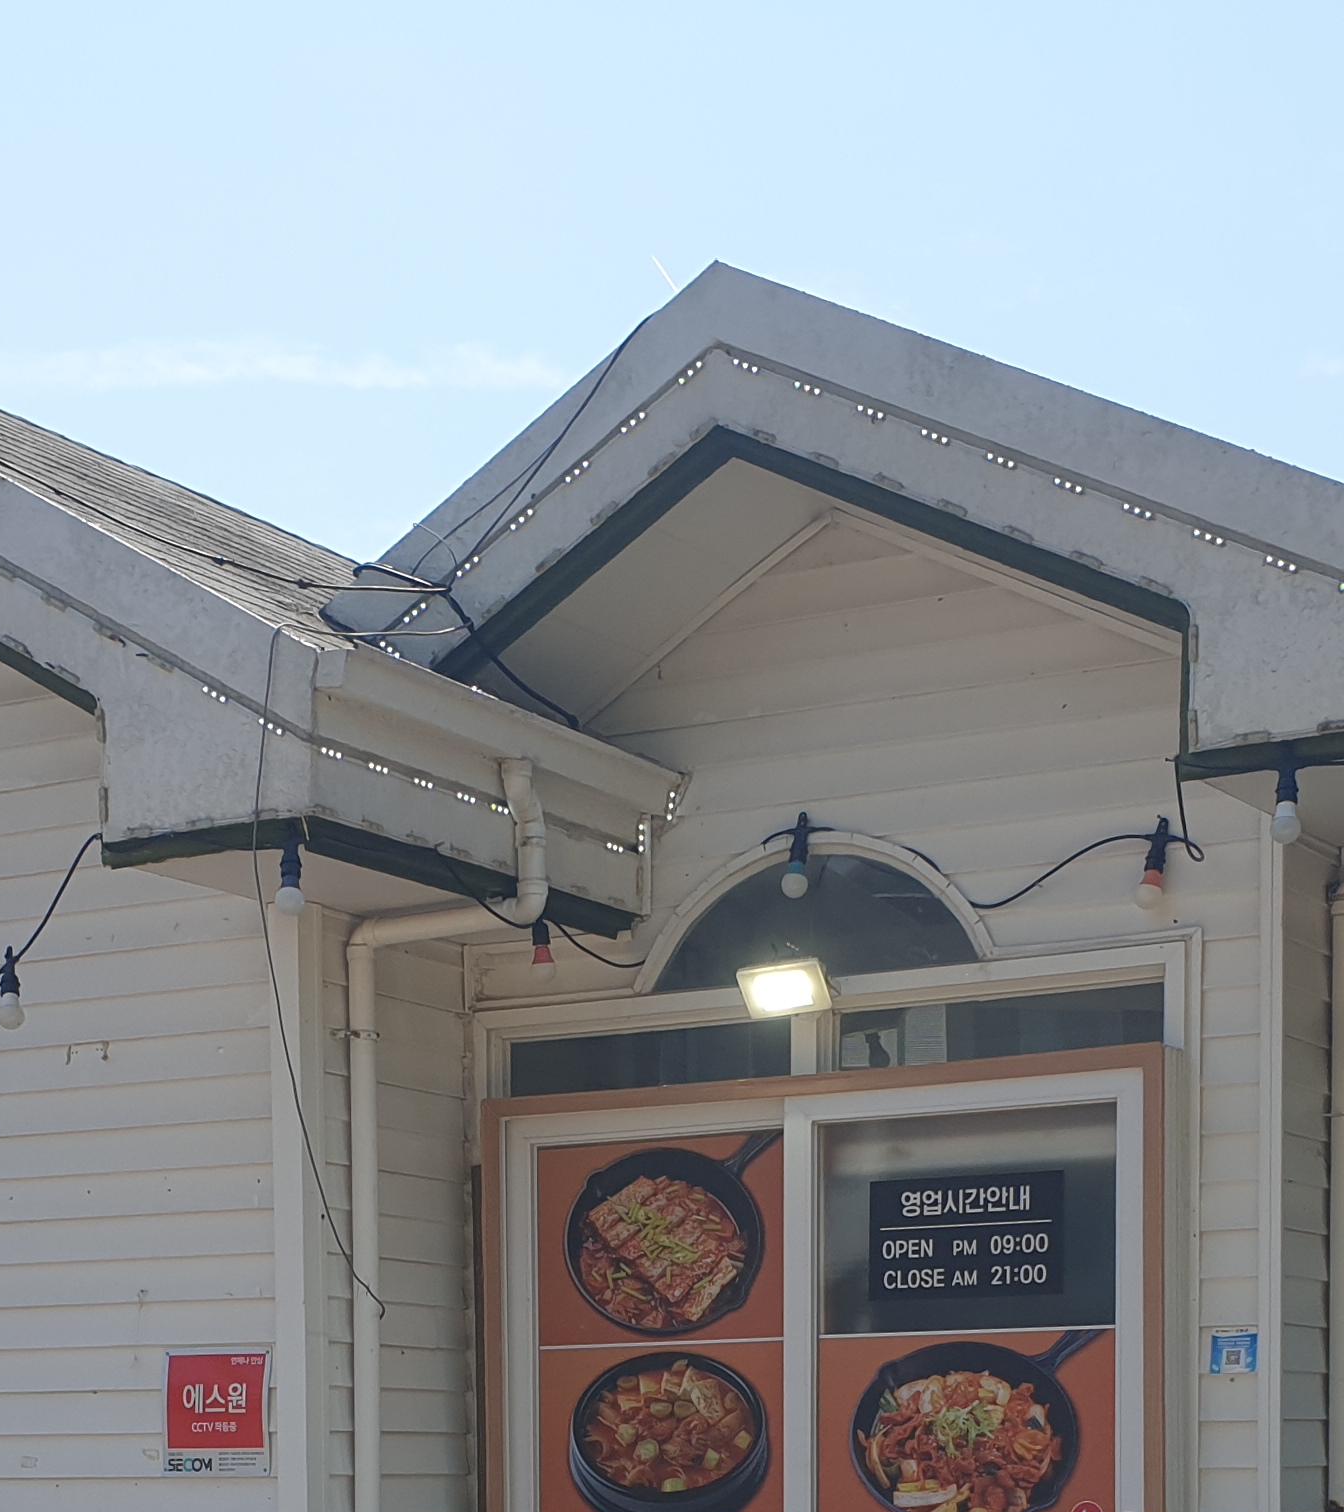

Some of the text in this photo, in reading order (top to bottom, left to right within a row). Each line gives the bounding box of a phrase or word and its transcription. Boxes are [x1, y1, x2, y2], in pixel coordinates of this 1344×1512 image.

[900, 1185, 1031, 1217] 영업시간안내
[882, 1233, 1049, 1260] OPEN PM 09:00
[883, 1264, 1047, 1290] CLOSE AM 21:00
[182, 1382, 247, 1414] 에스원
[191, 1422, 214, 1433] CCTV
[167, 1457, 213, 1473] SECOM
